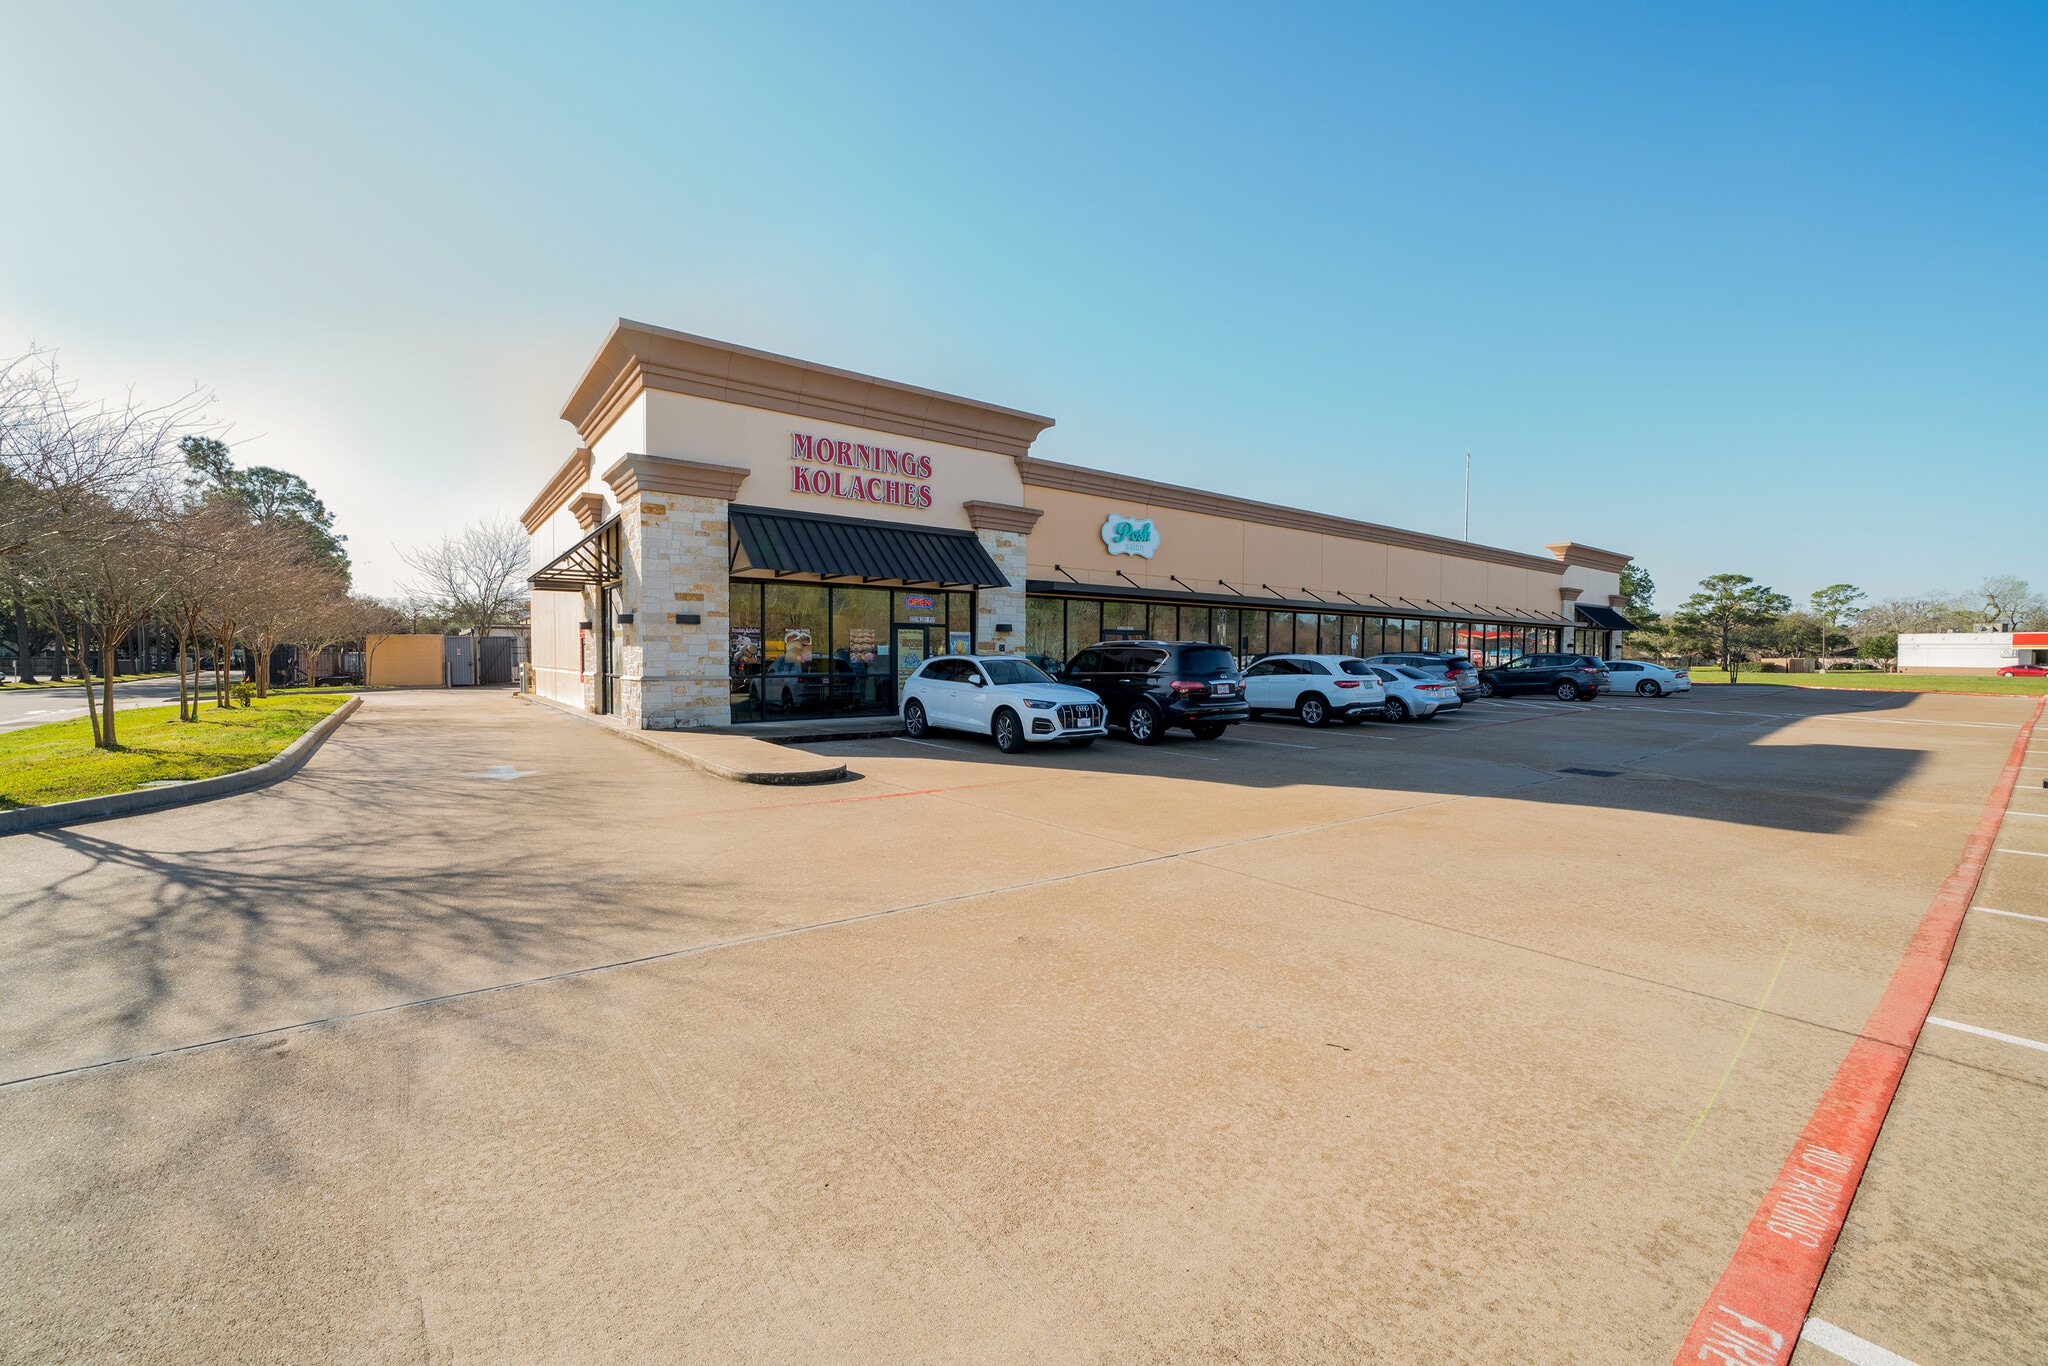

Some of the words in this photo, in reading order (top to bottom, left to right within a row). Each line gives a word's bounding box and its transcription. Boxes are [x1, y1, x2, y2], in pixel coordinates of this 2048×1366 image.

[792, 432, 933, 479] MORNINGS
[792, 465, 933, 509] KOLACHES
[1113, 521, 1151, 543] Posh
[1124, 543, 1144, 552] salon
[907, 598, 931, 607] OPEN
[1802, 1143, 1854, 1175] NO
[1766, 1168, 1844, 1248] PARKING
